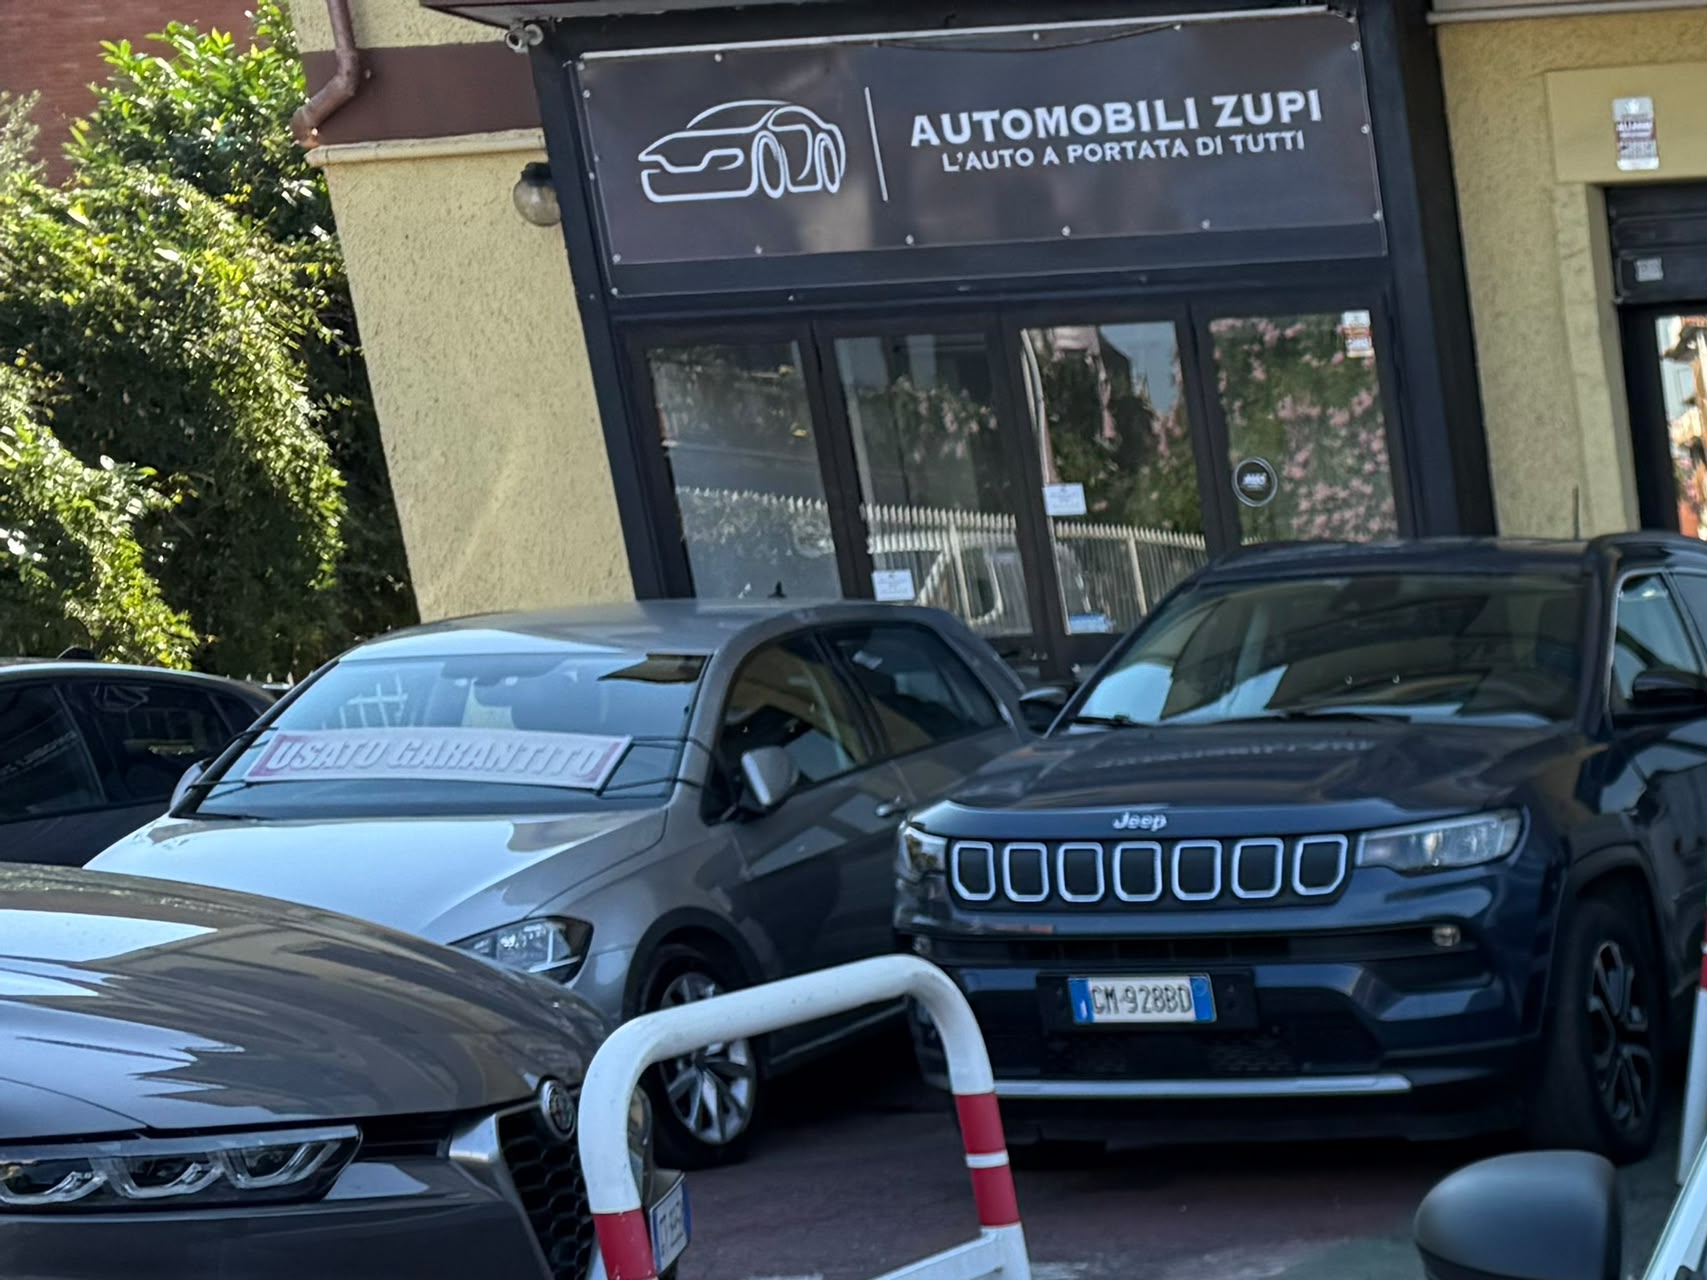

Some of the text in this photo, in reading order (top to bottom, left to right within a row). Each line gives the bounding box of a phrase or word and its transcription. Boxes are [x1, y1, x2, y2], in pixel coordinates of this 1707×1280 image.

[910, 88, 1323, 148] AUTOMOBILI ZUPI
[942, 129, 1306, 173] L'AUTO A PORTATA DI TUTTI
[264, 736, 607, 779] USATO GARANTITO
[1112, 811, 1168, 832] Jeep
